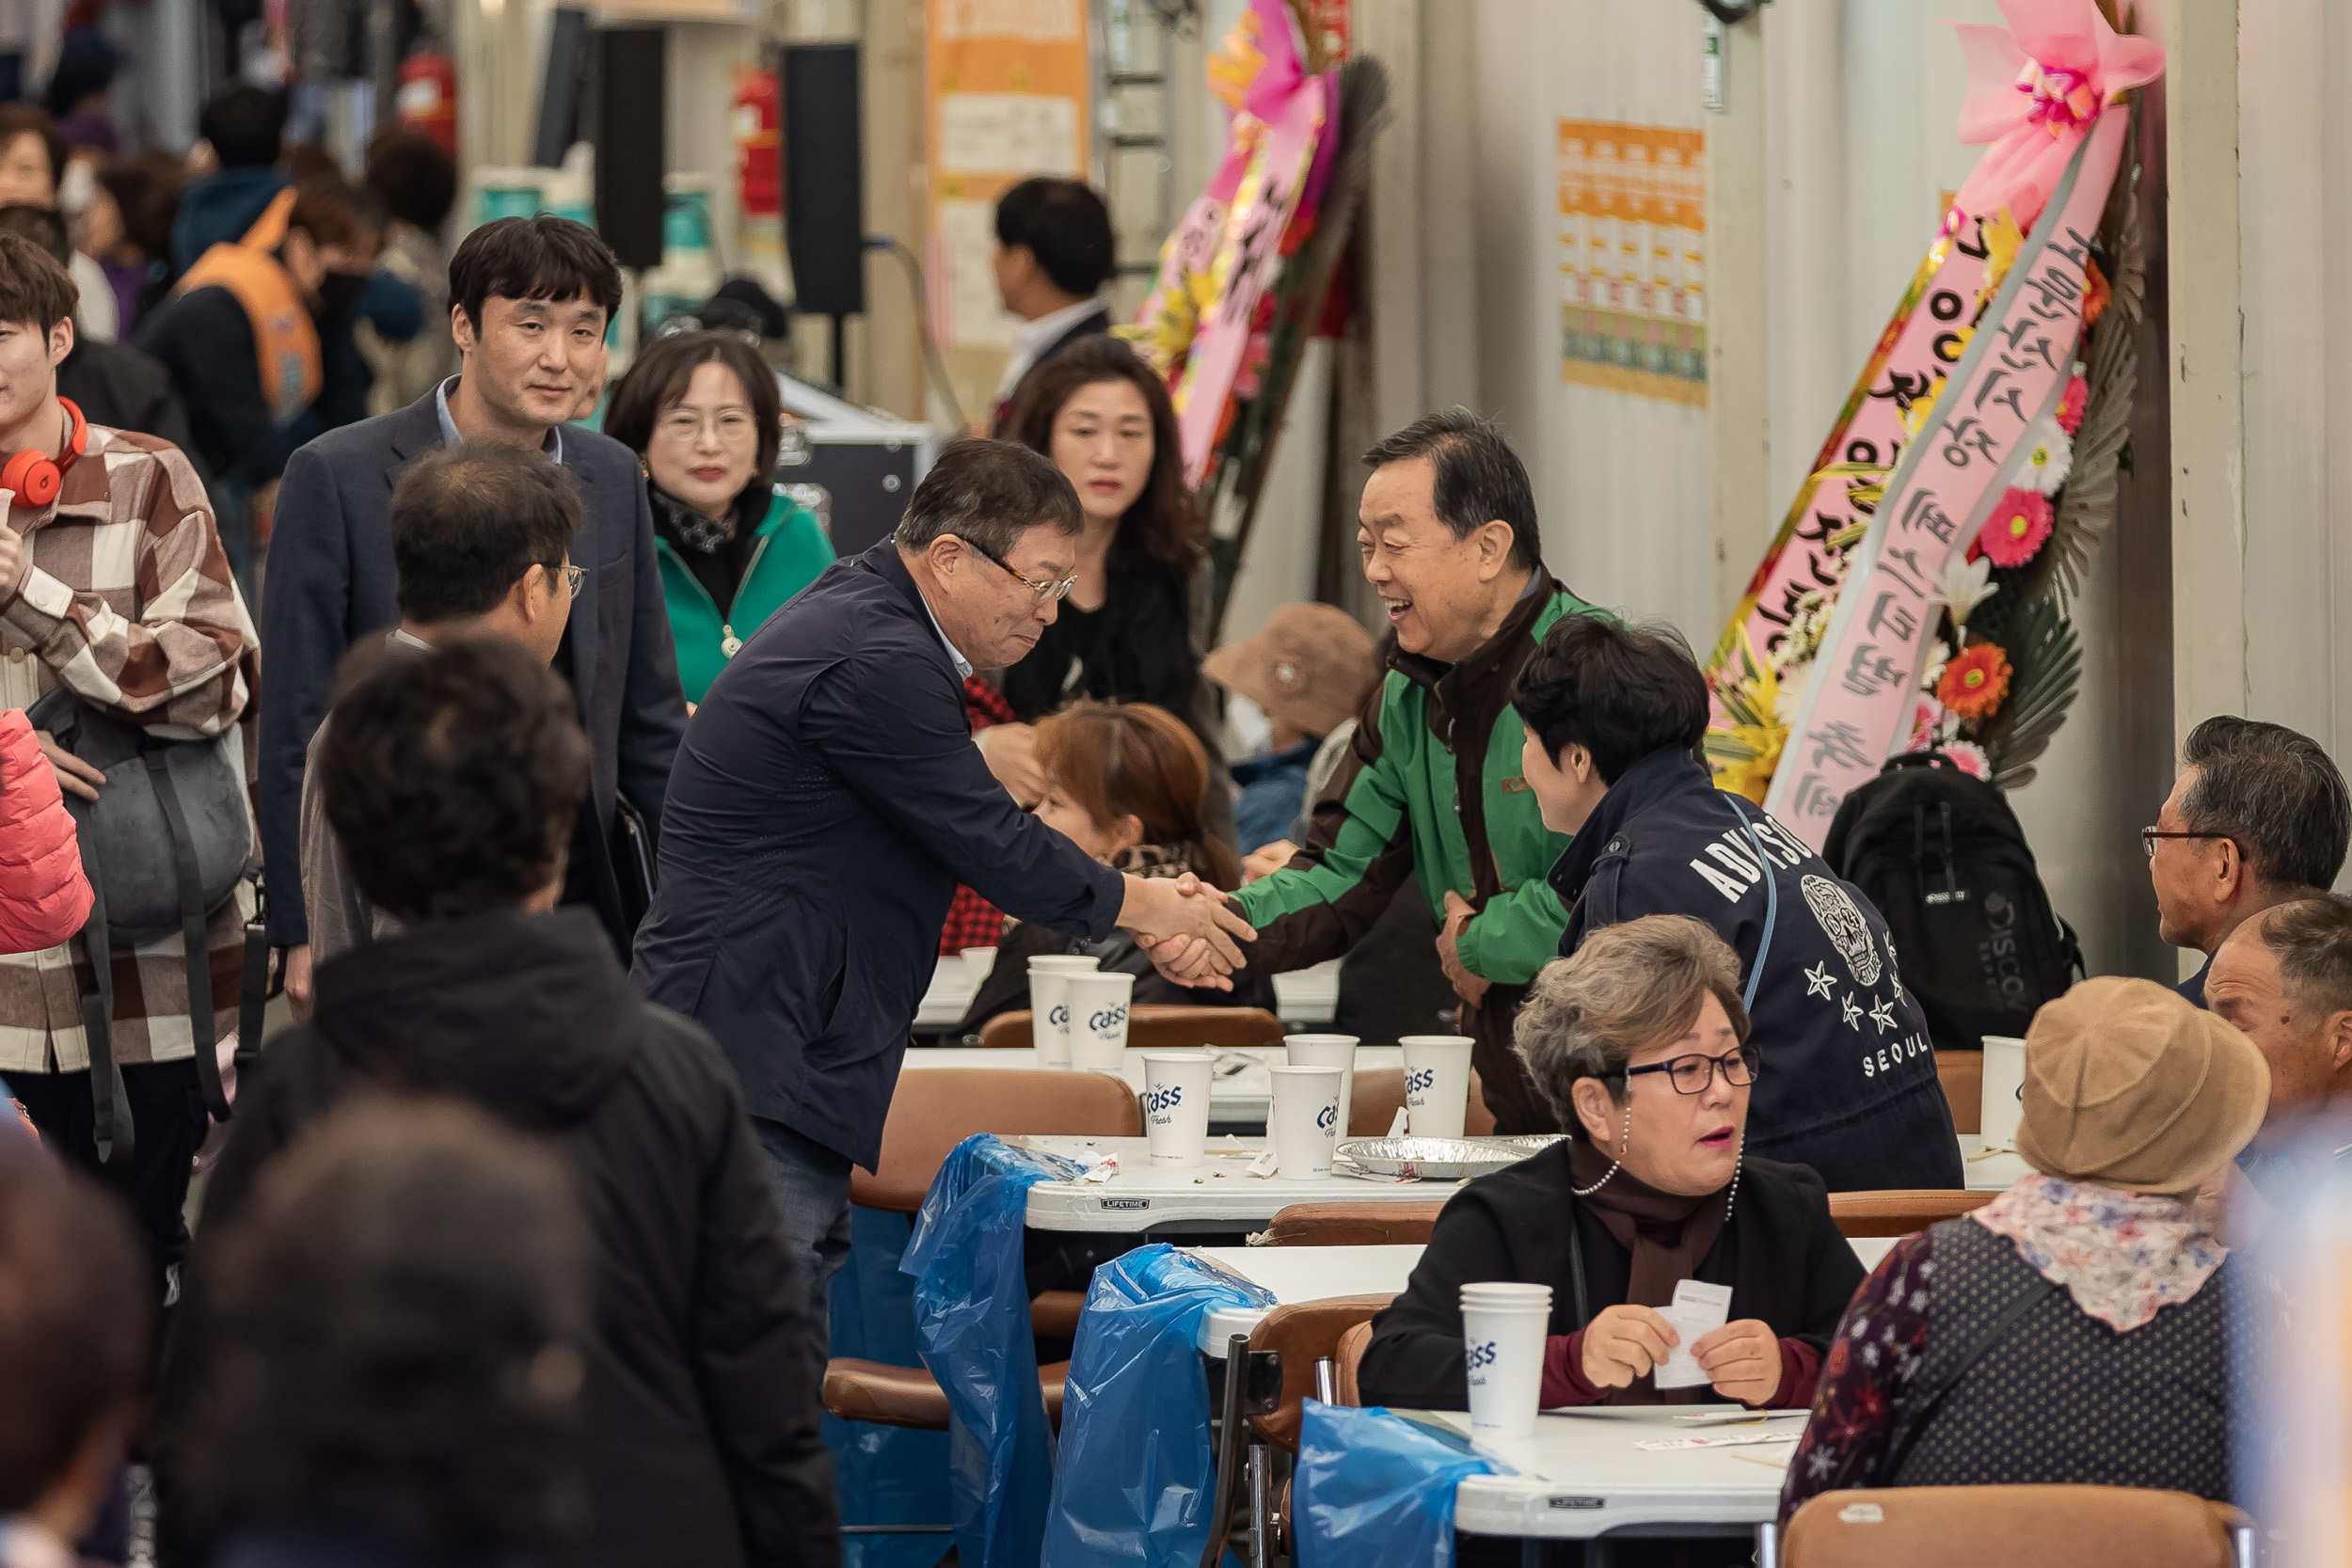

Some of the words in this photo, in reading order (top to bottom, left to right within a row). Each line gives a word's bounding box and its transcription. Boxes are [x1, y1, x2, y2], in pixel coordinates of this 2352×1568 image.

[1050, 1005, 1070, 1025] Ca
[1863, 1032, 1928, 1077] SEOUL
[1405, 1069, 1434, 1094] ass
[1151, 1115, 1172, 1125] Fresh
[1317, 1101, 1339, 1129] Ca
